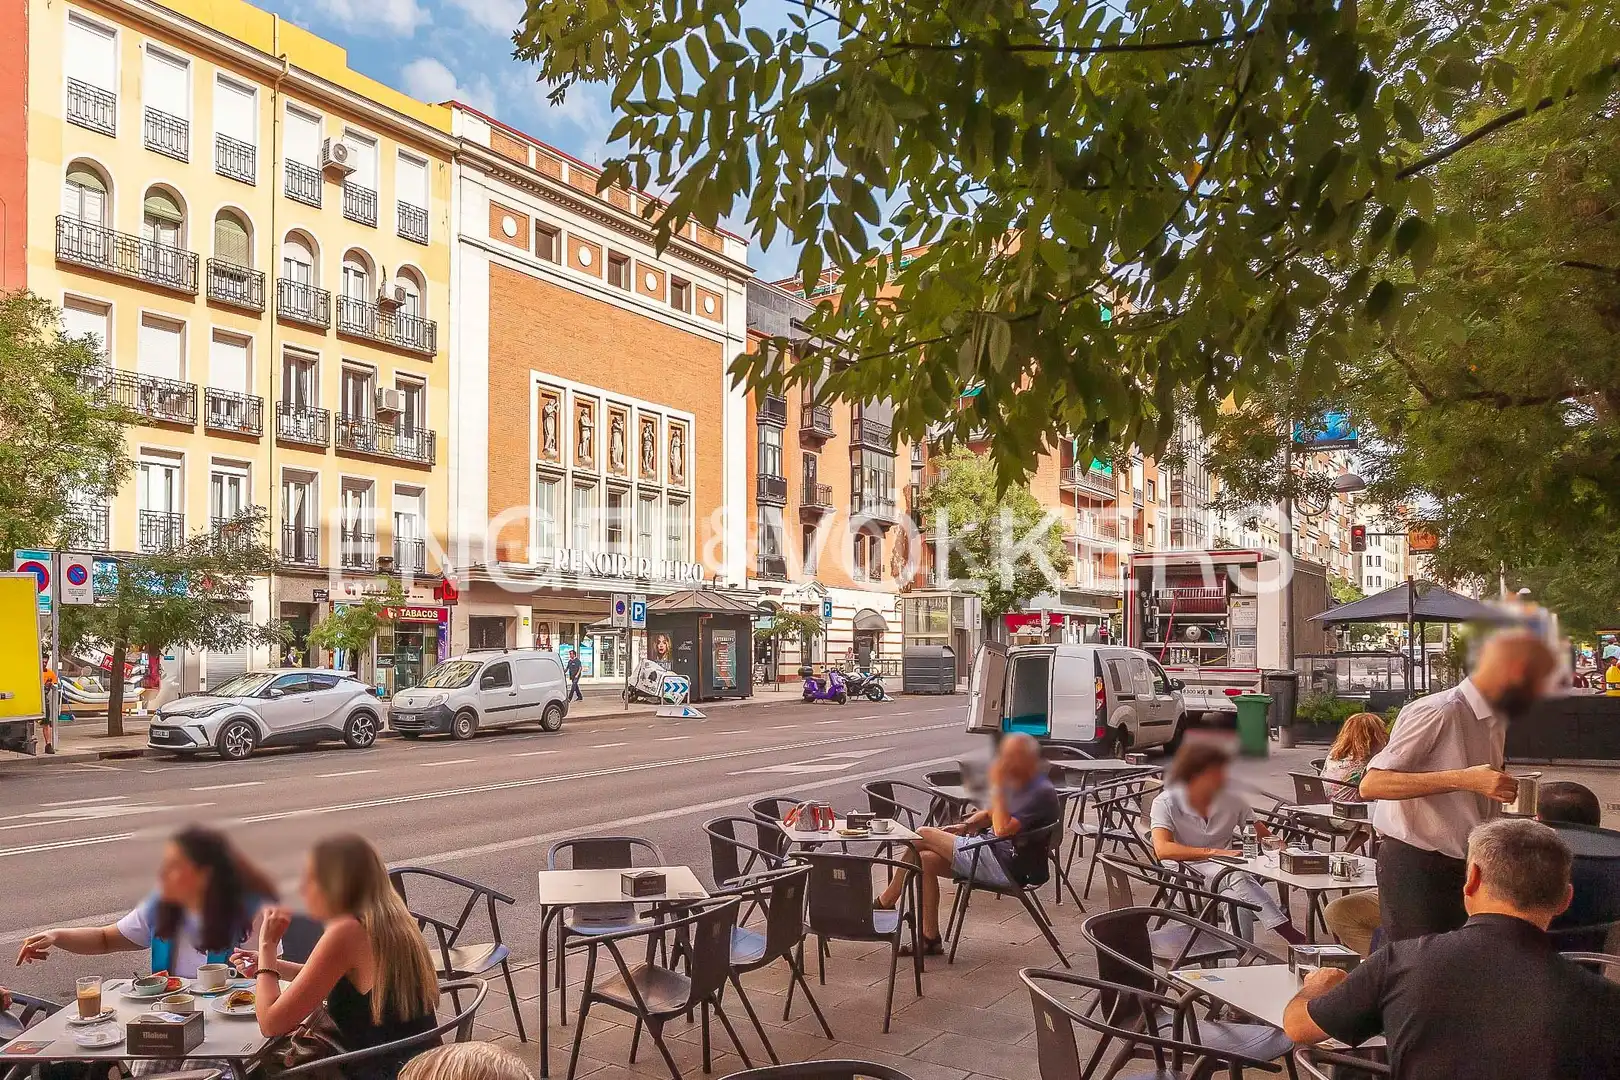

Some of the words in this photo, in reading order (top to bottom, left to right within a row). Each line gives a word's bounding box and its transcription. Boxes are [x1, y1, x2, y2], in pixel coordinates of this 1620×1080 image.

[554, 549, 632, 578] RENOIR
[638, 557, 704, 583] RTIRO
[401, 608, 438, 618] TABACOS
[634, 603, 644, 620] P
